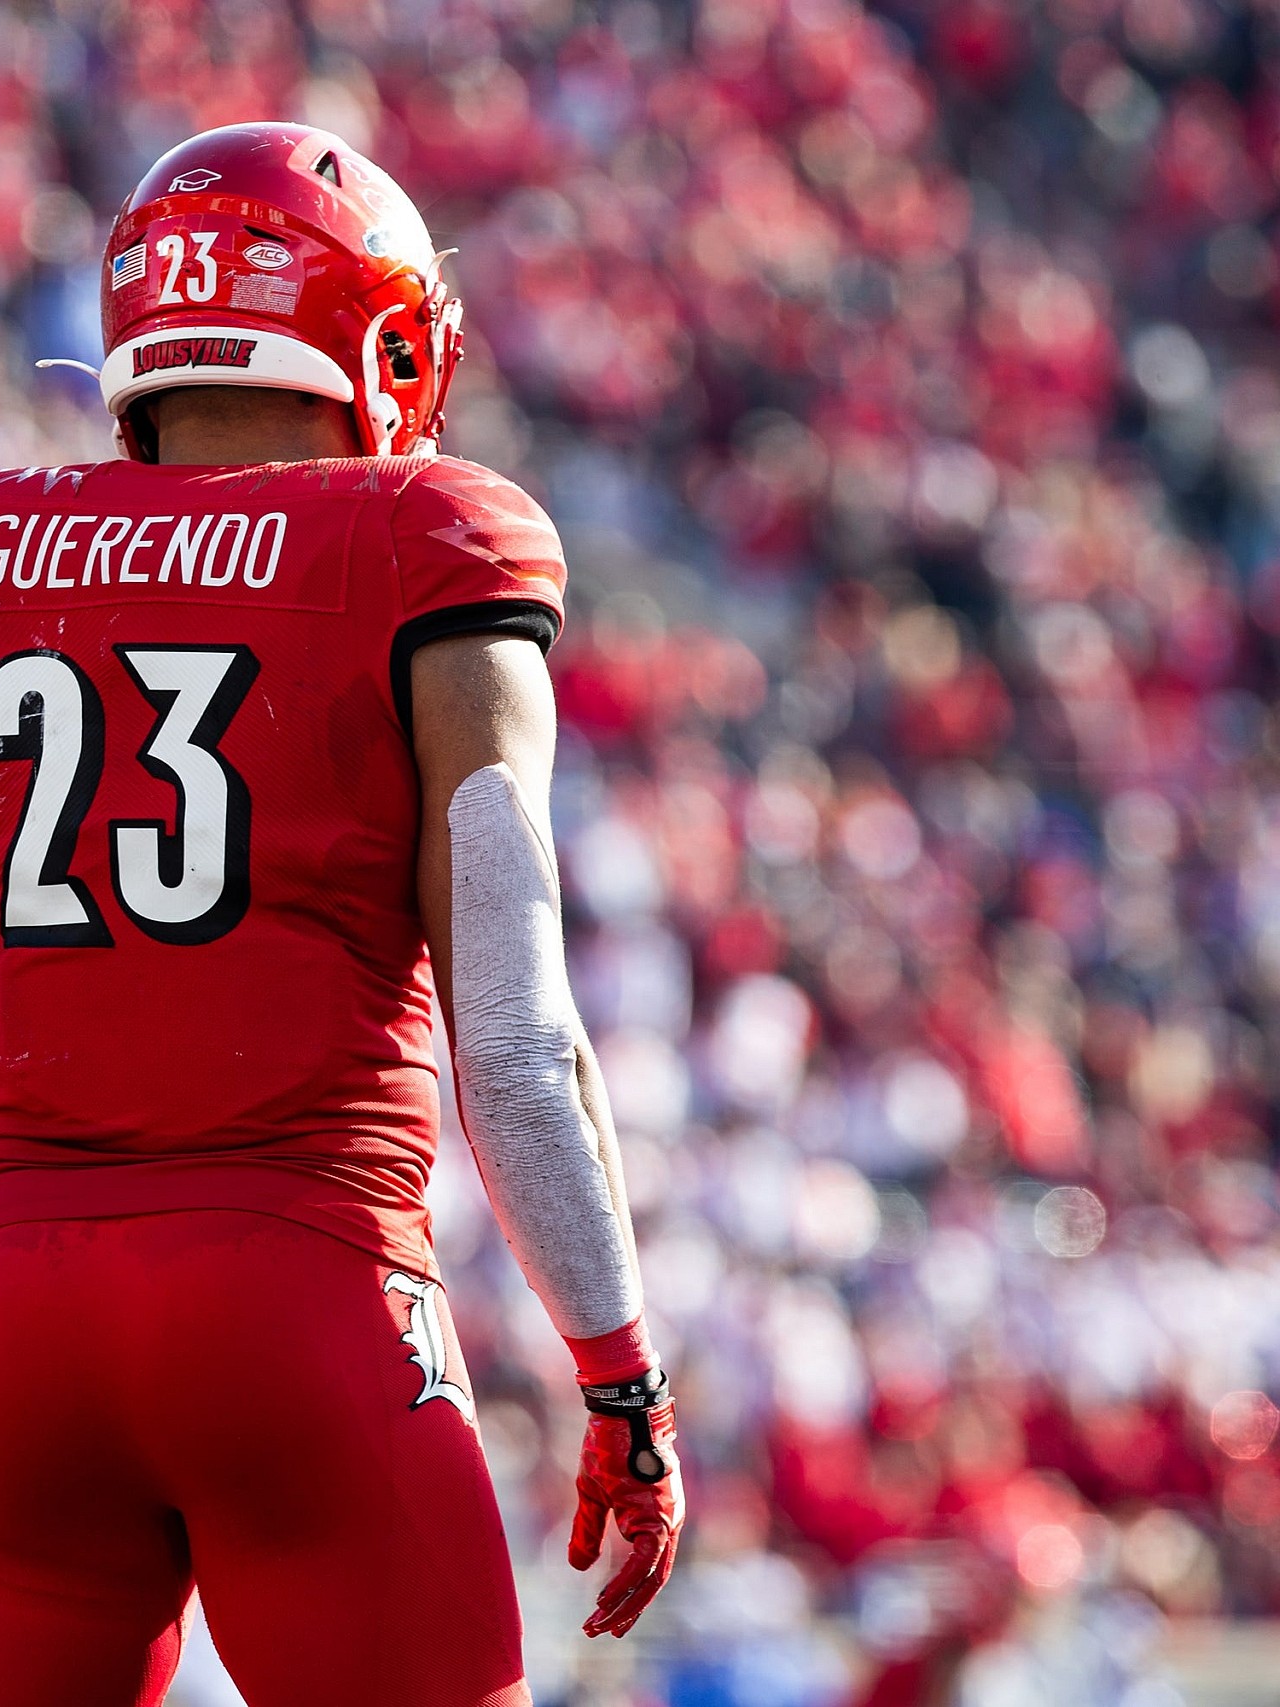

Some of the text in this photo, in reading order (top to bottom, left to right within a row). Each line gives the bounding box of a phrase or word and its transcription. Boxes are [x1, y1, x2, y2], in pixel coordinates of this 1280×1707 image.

[156, 232, 219, 305] 23
[251, 248, 285, 261] ACC
[132, 338, 258, 378] LOUISVILLE
